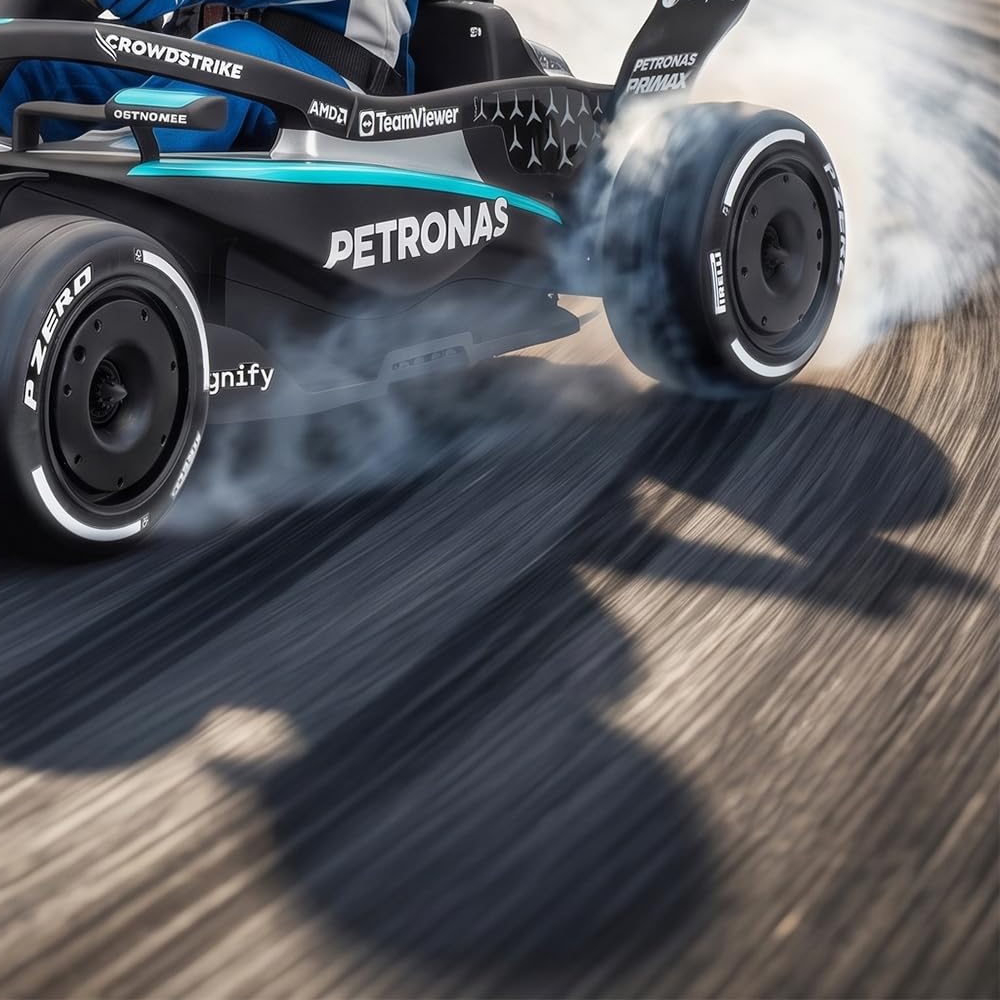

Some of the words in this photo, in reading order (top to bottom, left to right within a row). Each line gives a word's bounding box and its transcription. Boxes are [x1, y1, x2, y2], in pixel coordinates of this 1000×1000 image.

[105, 34, 244, 80] CROWDSTRIKE
[633, 53, 698, 72] PETRONAS
[626, 71, 690, 94] PRIMAX
[309, 100, 339, 121] AMD
[376, 107, 460, 133] TeamViewer
[323, 197, 509, 270] PETRONAS
[710, 251, 727, 315] PIRELLI
[24, 379, 38, 411] P
[31, 265, 93, 375] ZERO
[209, 364, 274, 395] gnify
